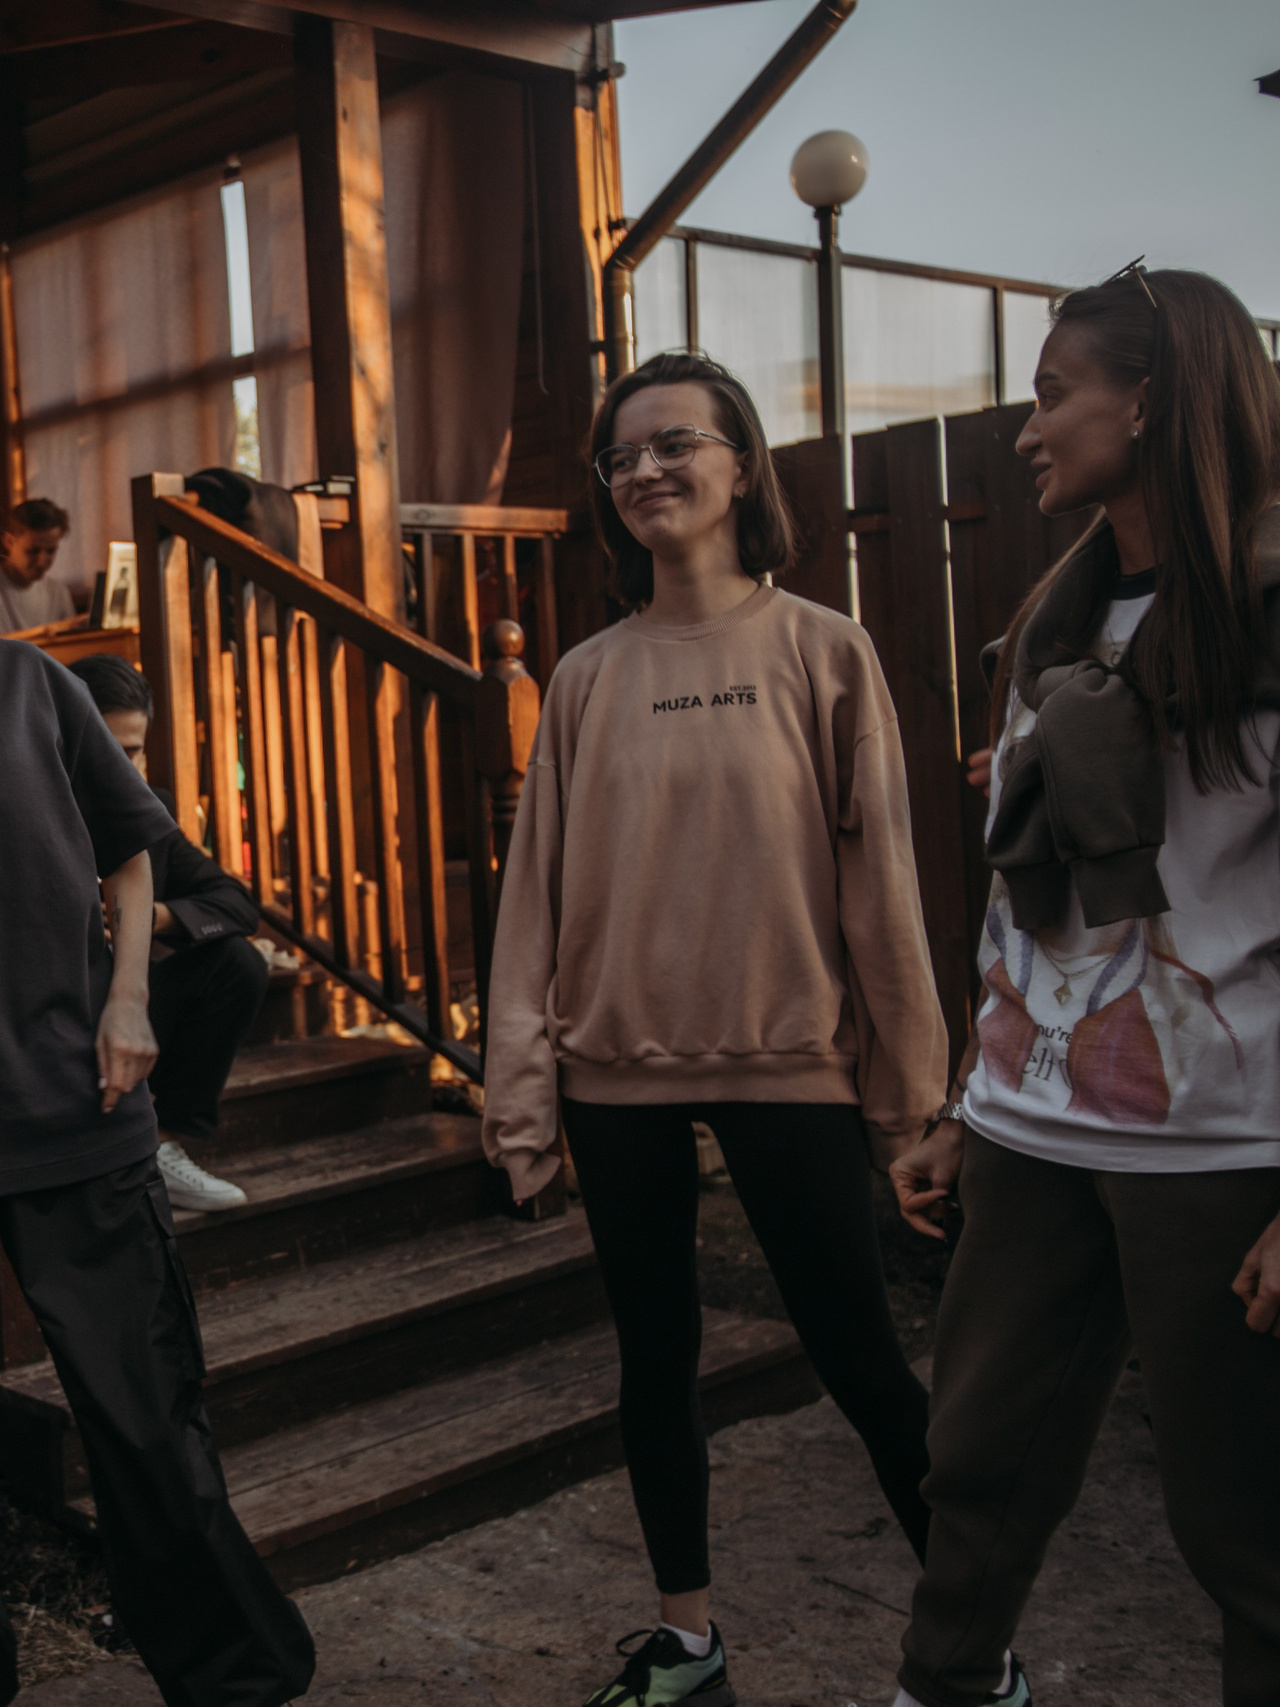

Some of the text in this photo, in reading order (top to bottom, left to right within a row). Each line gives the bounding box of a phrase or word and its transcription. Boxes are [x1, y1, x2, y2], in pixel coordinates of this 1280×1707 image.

[653, 692, 757, 714] MUZA ARTS
[1037, 1024, 1073, 1044] ou're
